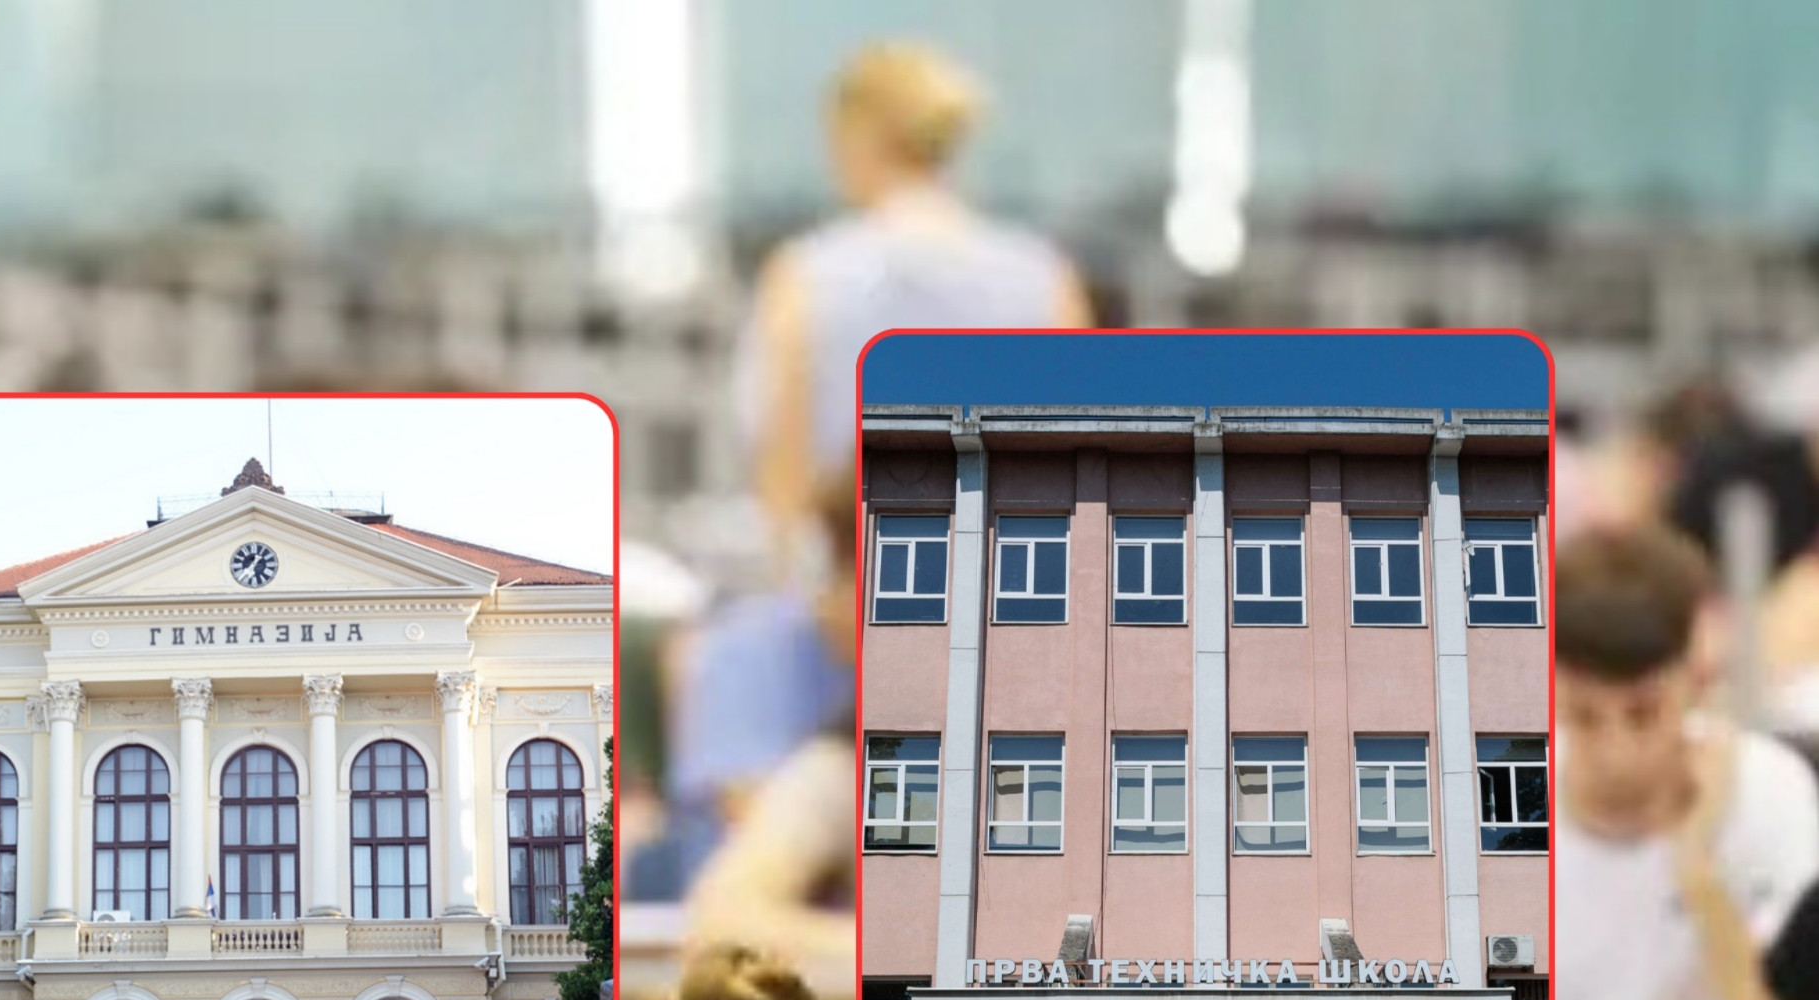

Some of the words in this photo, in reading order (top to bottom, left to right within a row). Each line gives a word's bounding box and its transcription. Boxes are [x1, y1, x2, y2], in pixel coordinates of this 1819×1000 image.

[149, 623, 363, 646] ГИМНАЗИЈА
[965, 958, 1070, 984] ПРВА
[1088, 958, 1299, 984] ТЕХНИЧКА
[1318, 958, 1461, 984] ШКОЛА
